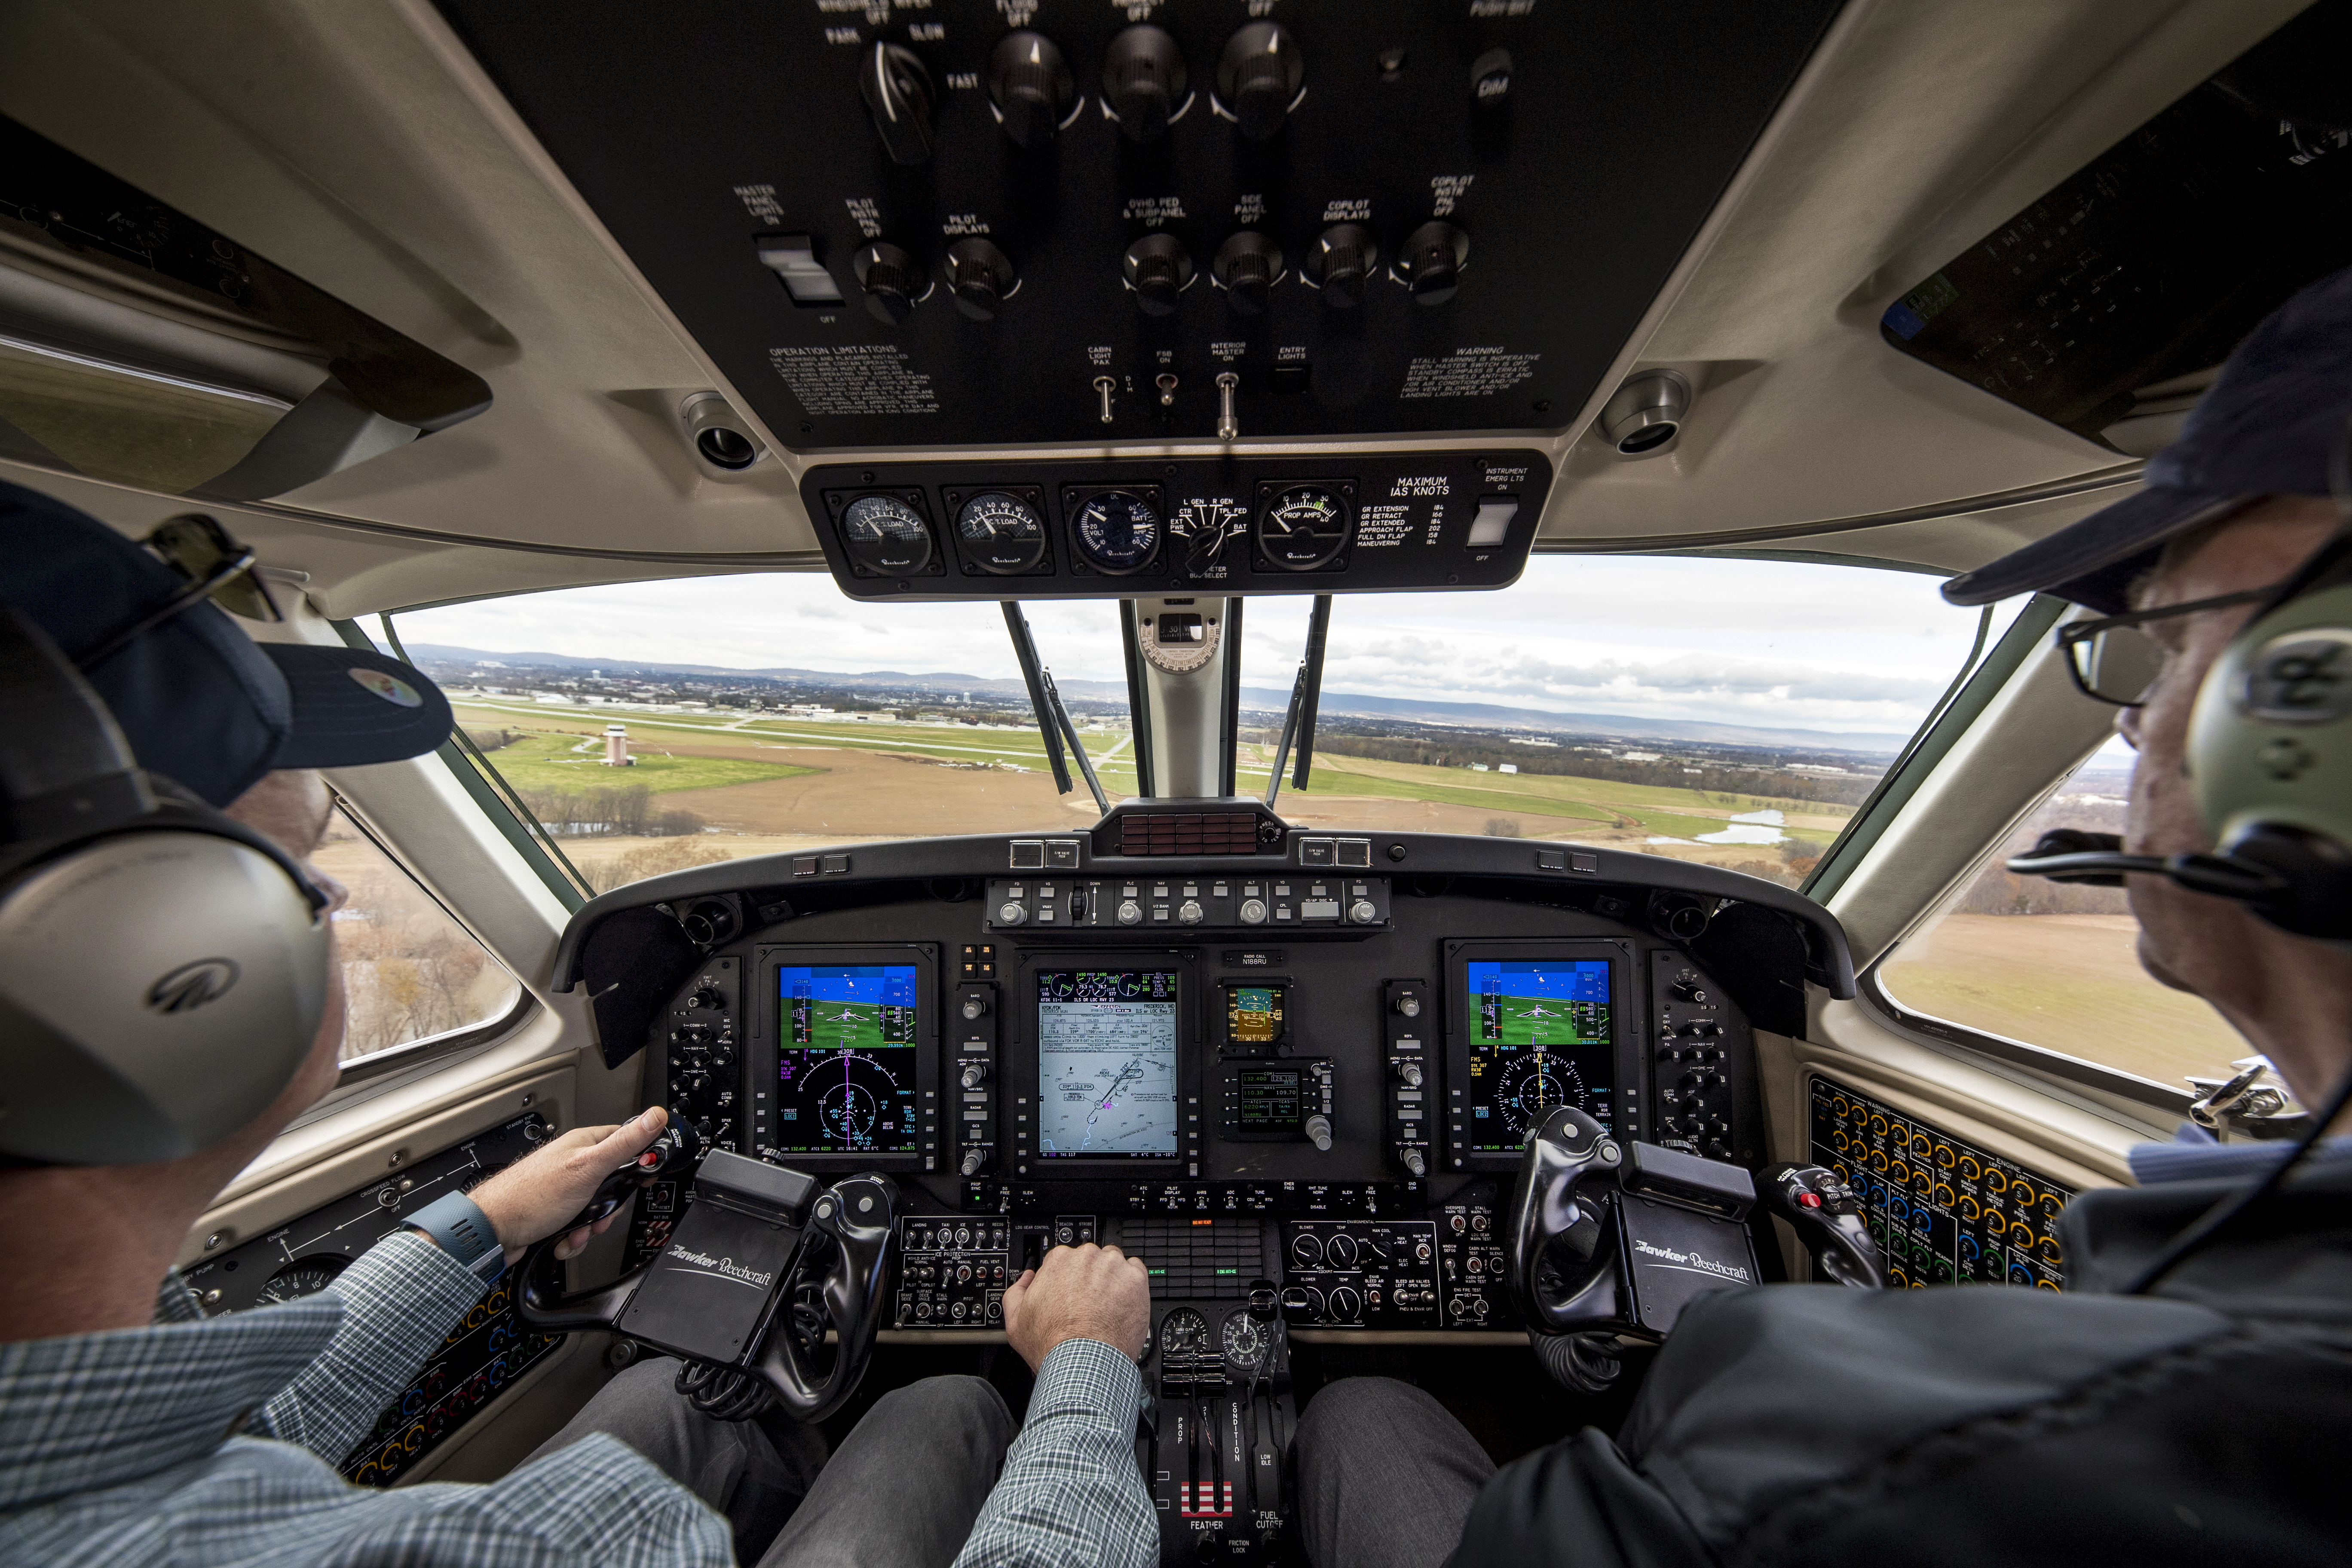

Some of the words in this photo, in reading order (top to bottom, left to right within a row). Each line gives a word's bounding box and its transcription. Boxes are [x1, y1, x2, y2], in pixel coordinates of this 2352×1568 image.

[948, 74, 977, 88] FAST
[949, 214, 976, 224] PILOT
[943, 224, 989, 234] DISPLAYS
[770, 347, 829, 356] OPERATION
[832, 346, 896, 354] LIMITATIONS
[1457, 347, 1504, 355] WARNING
[1397, 477, 1447, 487] MAXIMUM
[1390, 487, 1408, 496] IAS
[1413, 486, 1449, 496] KNOTS
[1868, 1101, 1890, 1115] WARNING
[506, 1119, 523, 1129] STANDBY
[1913, 1152, 1931, 1163] FEATHER
[1850, 1161, 1868, 1173] FLIGHT
[1915, 1165, 1928, 1174] STALL
[1997, 1158, 2020, 1173] ENGINE
[360, 1181, 390, 1198] CROSSFEED
[391, 1174, 405, 1184] FLOW
[1929, 1203, 1949, 1217] LIGHTS
[267, 1229, 289, 1242] ENGINE
[1935, 1252, 1953, 1265] READING
[718, 1258, 772, 1285] Beechcraft
[1689, 1253, 1749, 1280] Beechcraft
[2039, 1266, 2061, 1280] AVIONICS
